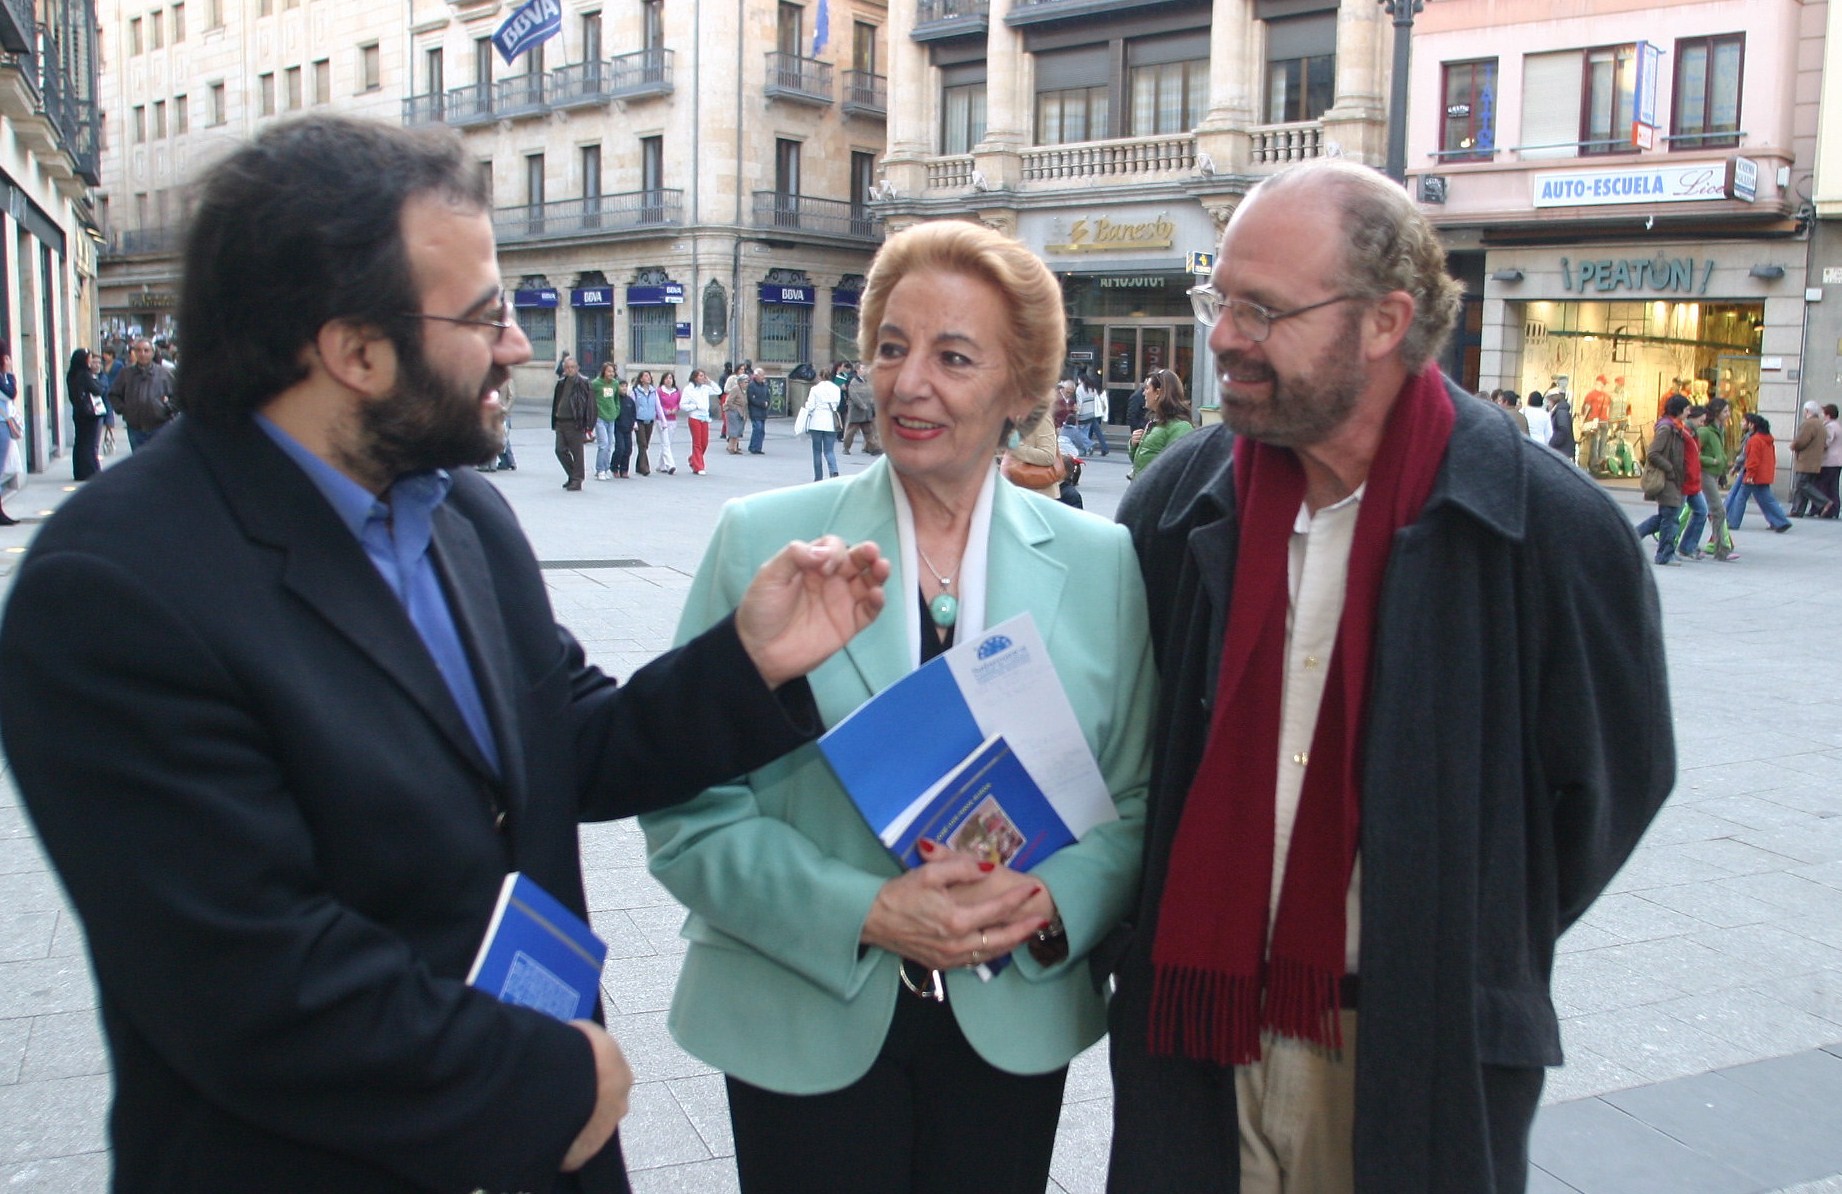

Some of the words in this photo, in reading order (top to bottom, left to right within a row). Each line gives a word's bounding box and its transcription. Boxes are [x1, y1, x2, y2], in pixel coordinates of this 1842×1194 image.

[501, 0, 559, 50] BBVA
[1541, 175, 1664, 199] AUTO-ESCUELA
[584, 291, 602, 302] BBVA
[782, 288, 804, 300] BBVA
